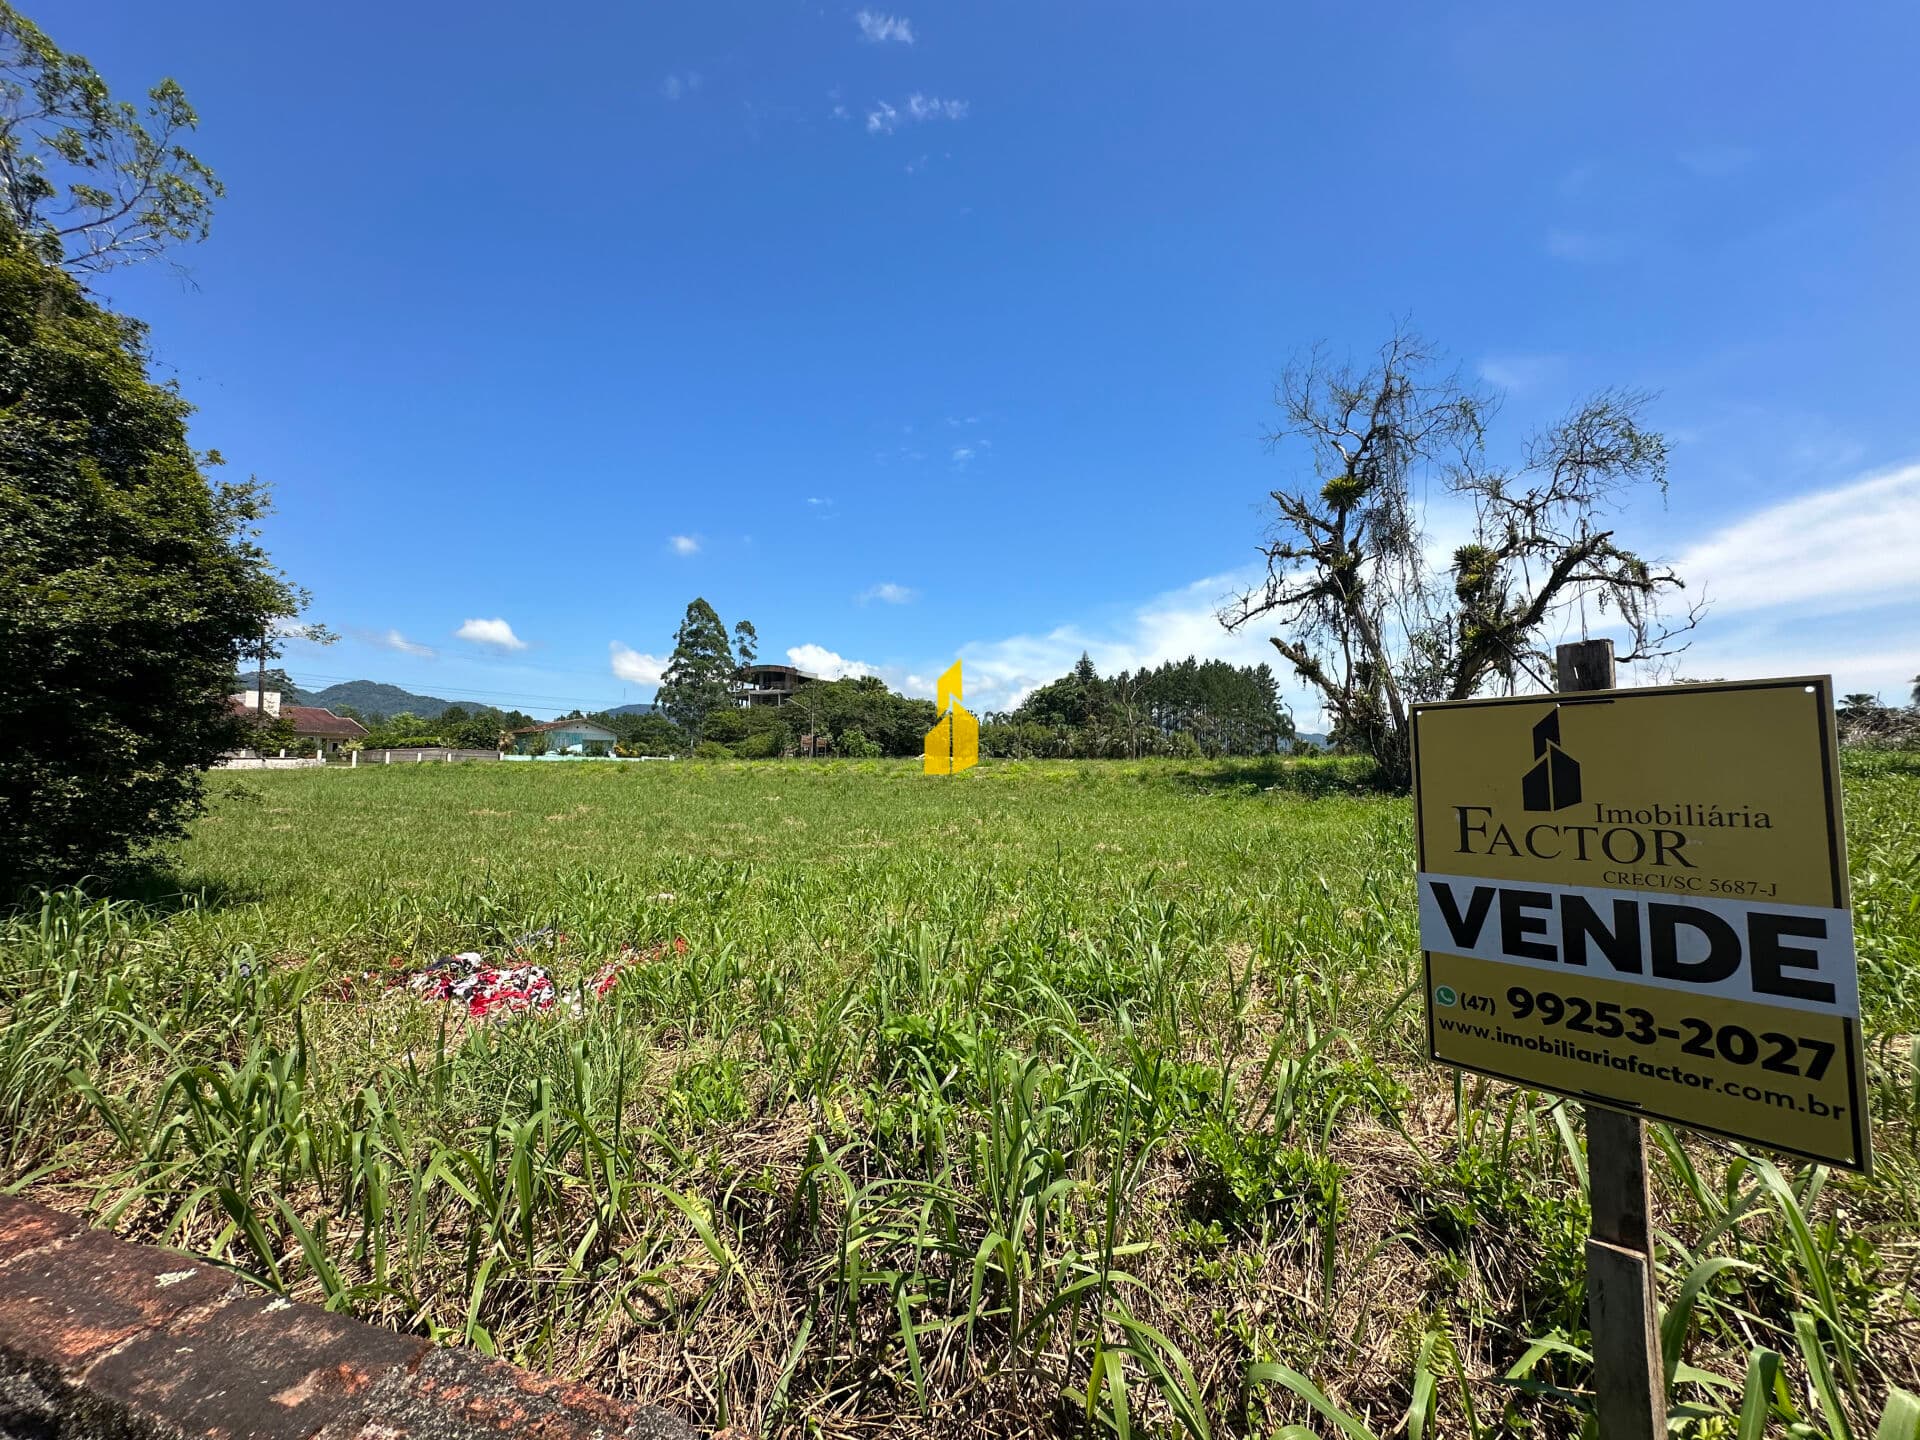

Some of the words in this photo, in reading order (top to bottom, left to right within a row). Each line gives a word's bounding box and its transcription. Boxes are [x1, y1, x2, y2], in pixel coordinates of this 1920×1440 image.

[1452, 805, 1698, 868] FACTOR
[1594, 801, 1773, 829] Imobiliária
[1603, 870, 1702, 892] CRECI/SC
[1709, 878, 1777, 897] 5687-J
[1429, 881, 1837, 1004] VENDE
[1438, 1016, 1846, 1121] www.imobiliariafactor.com.br
[1460, 992, 1496, 1017] (47)
[1506, 986, 1836, 1081] 99253-2027
